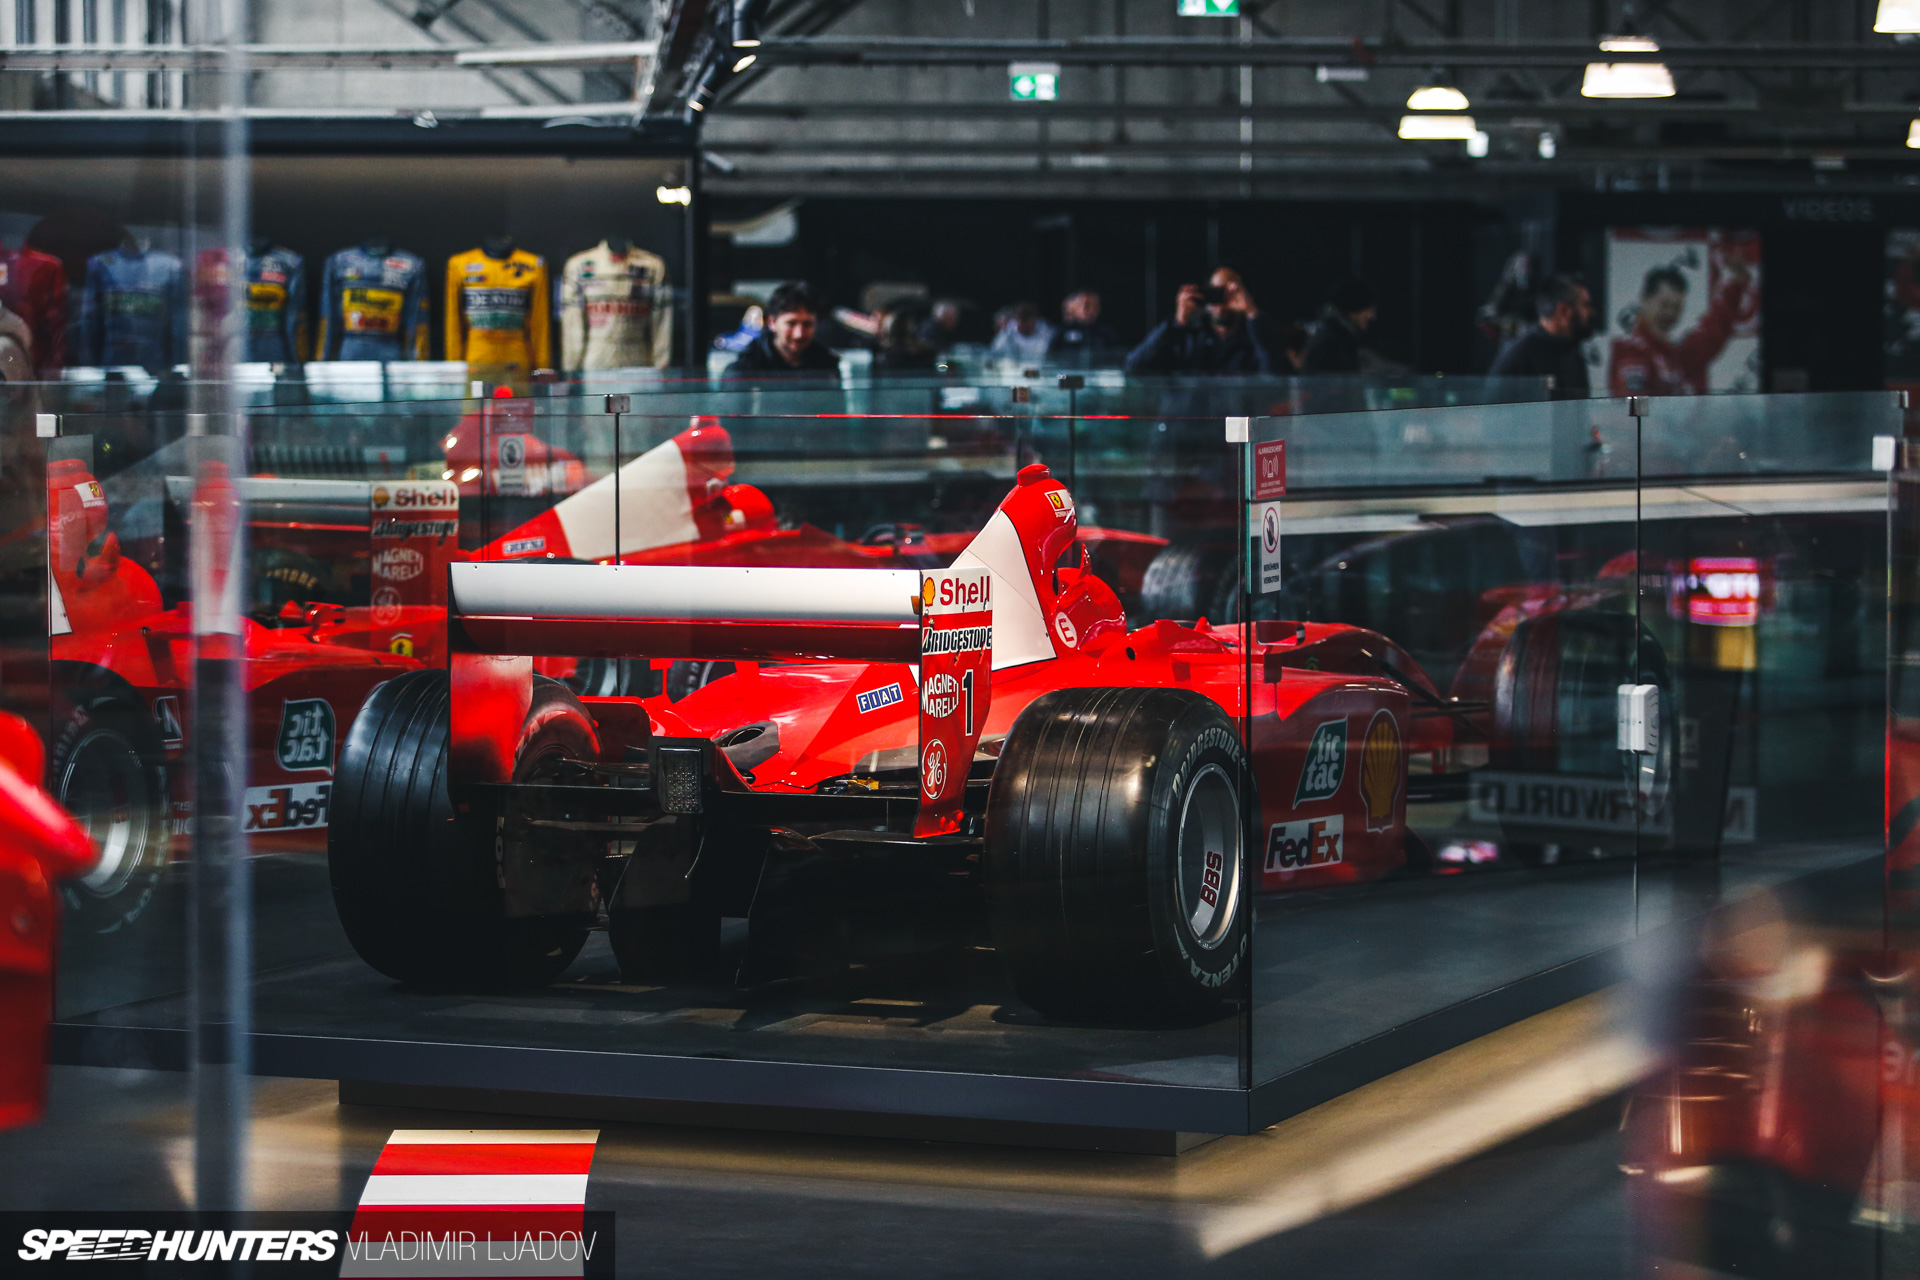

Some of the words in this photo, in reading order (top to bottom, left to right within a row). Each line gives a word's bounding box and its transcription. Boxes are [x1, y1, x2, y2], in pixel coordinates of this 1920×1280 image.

[394, 488, 457, 507] Shell
[939, 575, 990, 606] Shell
[922, 626, 992, 654] BRIDGESTONE
[858, 684, 902, 712] FIAT
[922, 673, 959, 698] MAGNETI
[922, 693, 959, 718] MARELLI
[962, 669, 974, 736] 1
[1317, 728, 1341, 764] tic
[1172, 727, 1241, 807] BRIDGESTONE
[1305, 756, 1339, 792] tac
[1266, 820, 1341, 870] FedEx
[1200, 852, 1222, 907] BBS
